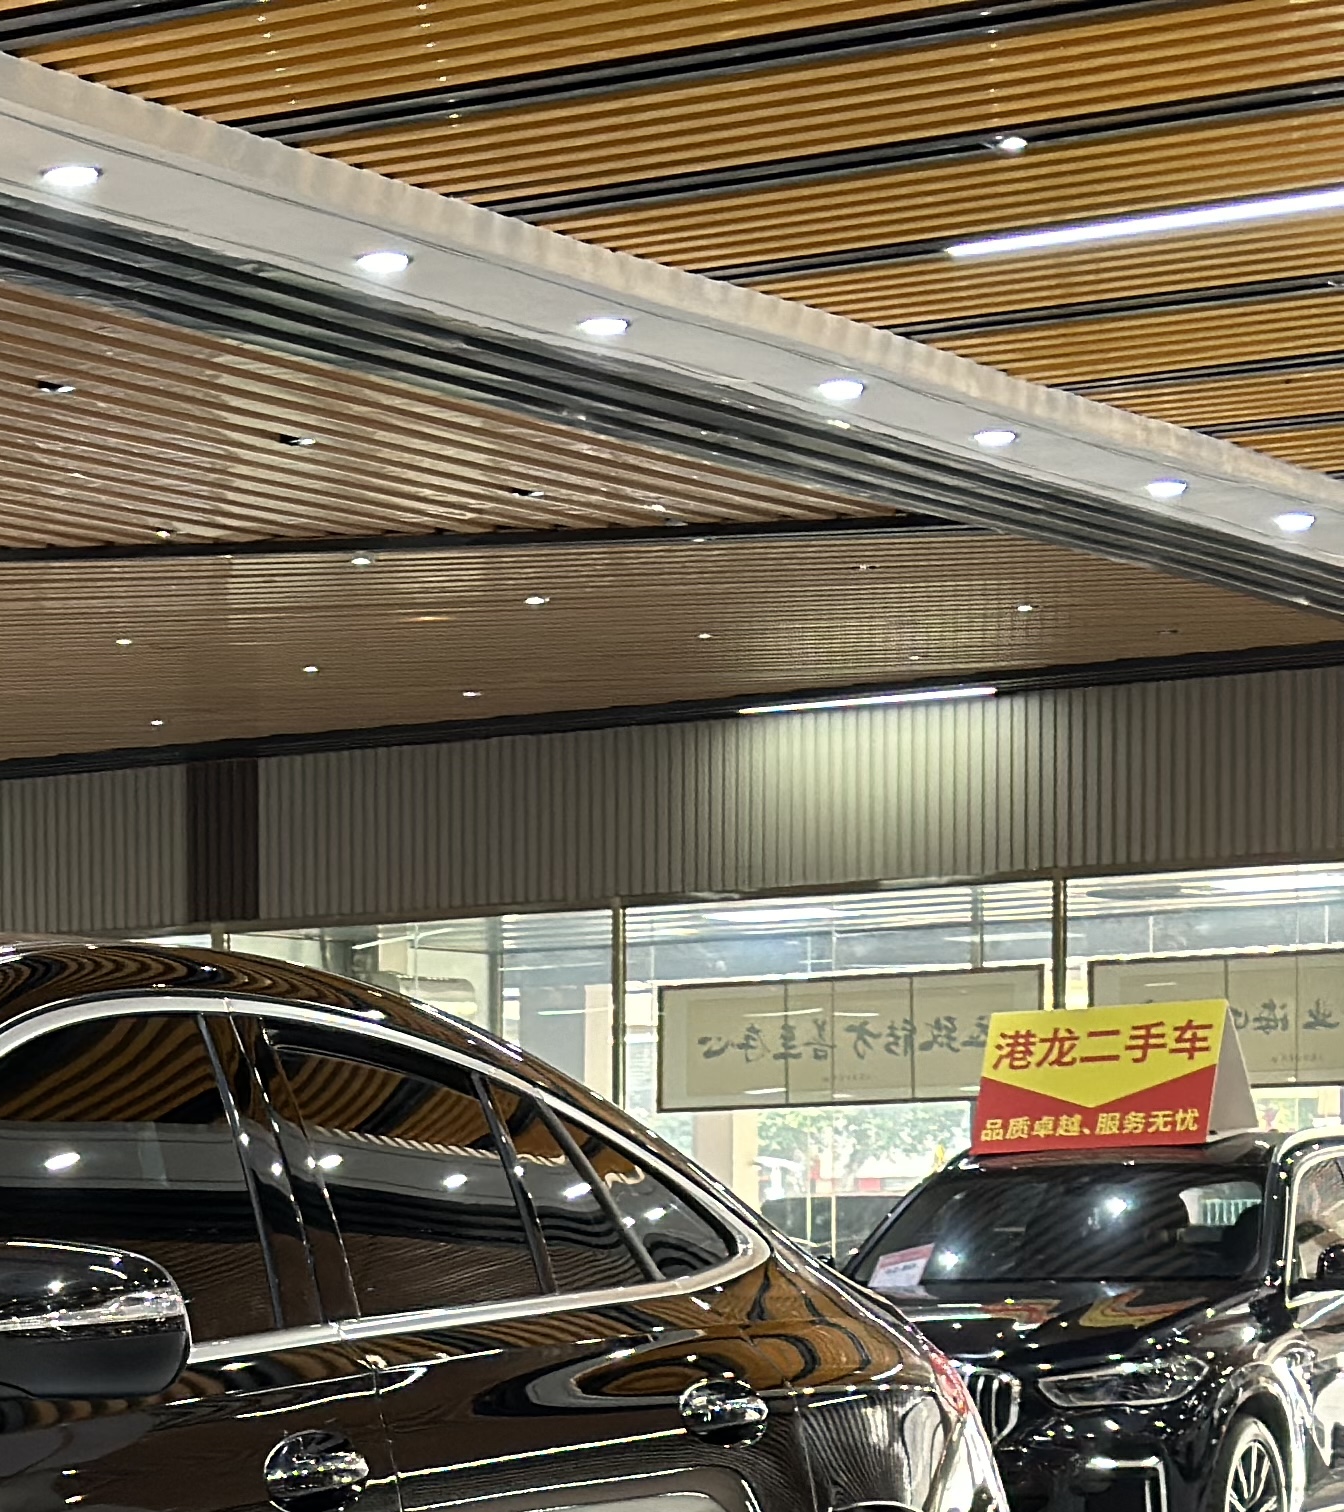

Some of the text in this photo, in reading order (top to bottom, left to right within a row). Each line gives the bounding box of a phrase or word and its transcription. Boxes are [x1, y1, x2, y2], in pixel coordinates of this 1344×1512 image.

[993, 1019, 1214, 1071] 港龙二手车
[980, 1108, 1200, 1141] 品质卓越、服务无忧
